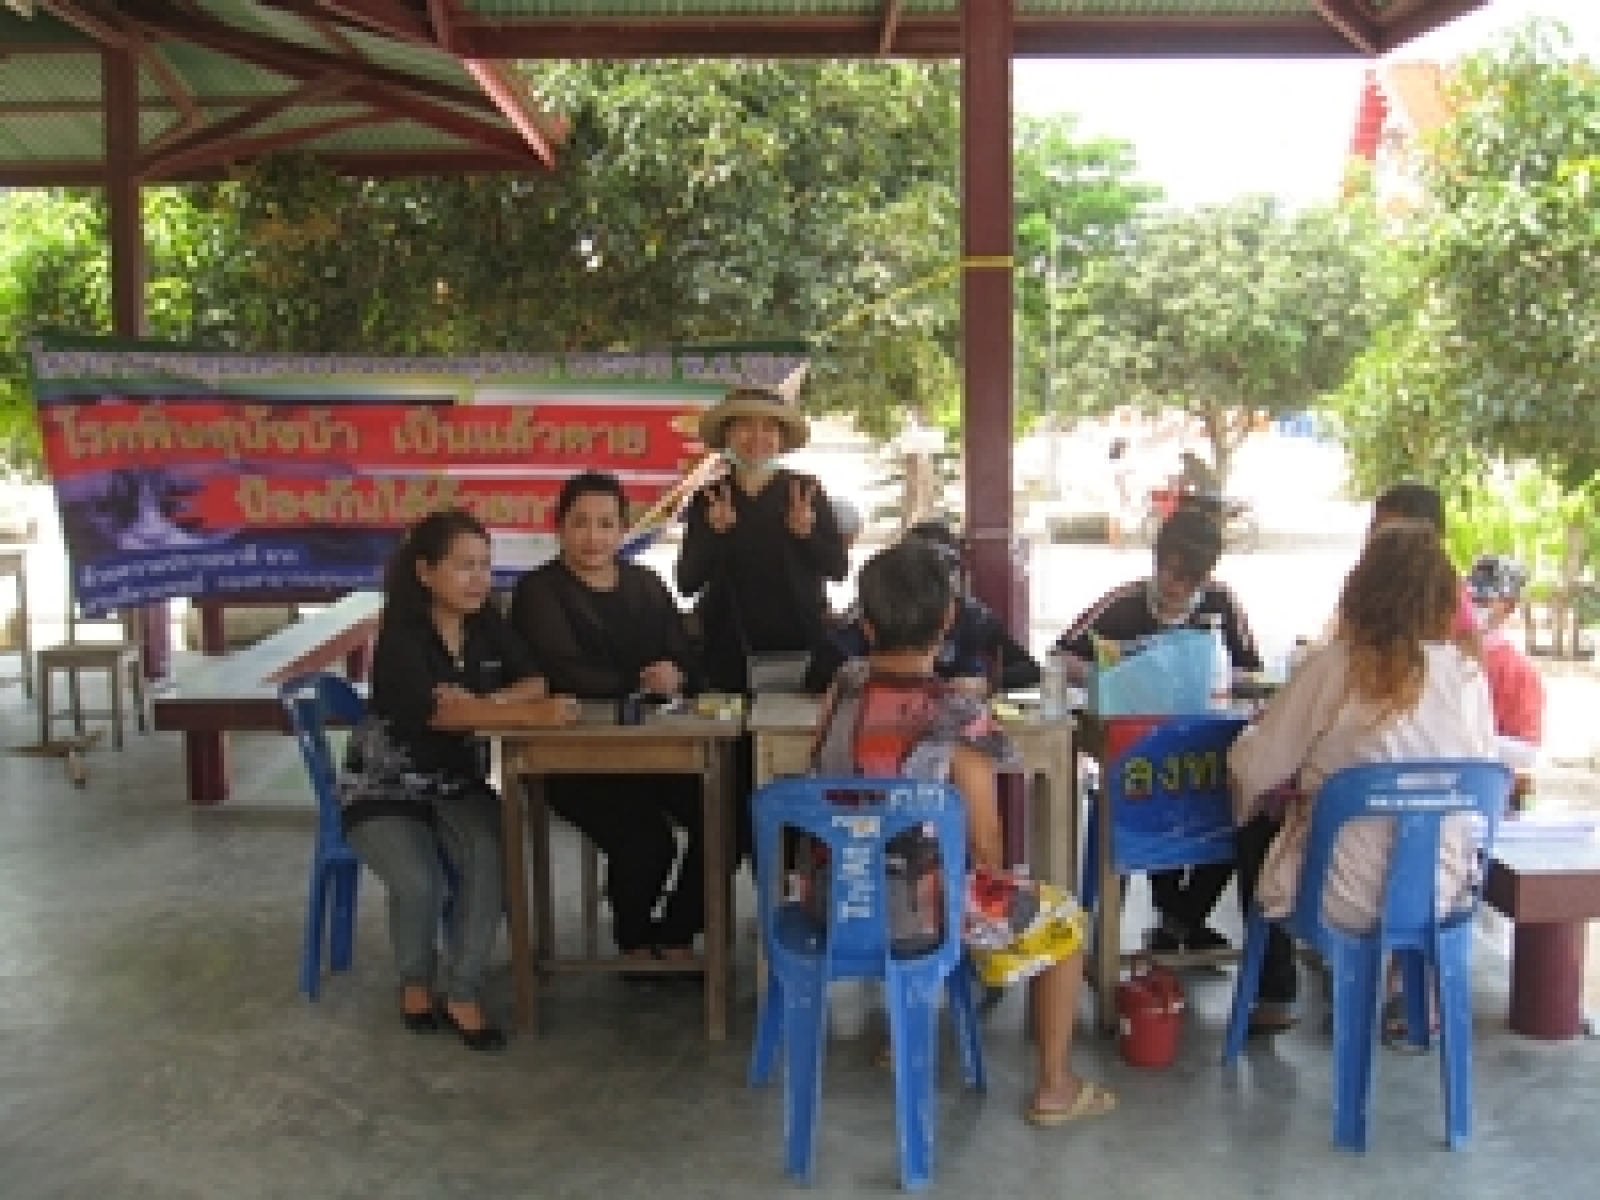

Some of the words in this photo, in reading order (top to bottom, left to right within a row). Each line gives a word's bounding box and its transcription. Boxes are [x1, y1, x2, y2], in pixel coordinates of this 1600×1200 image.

[52, 403, 360, 459] โรคพิษสุนัขบ้า
[391, 406, 648, 456] เป็นแล้วตาย
